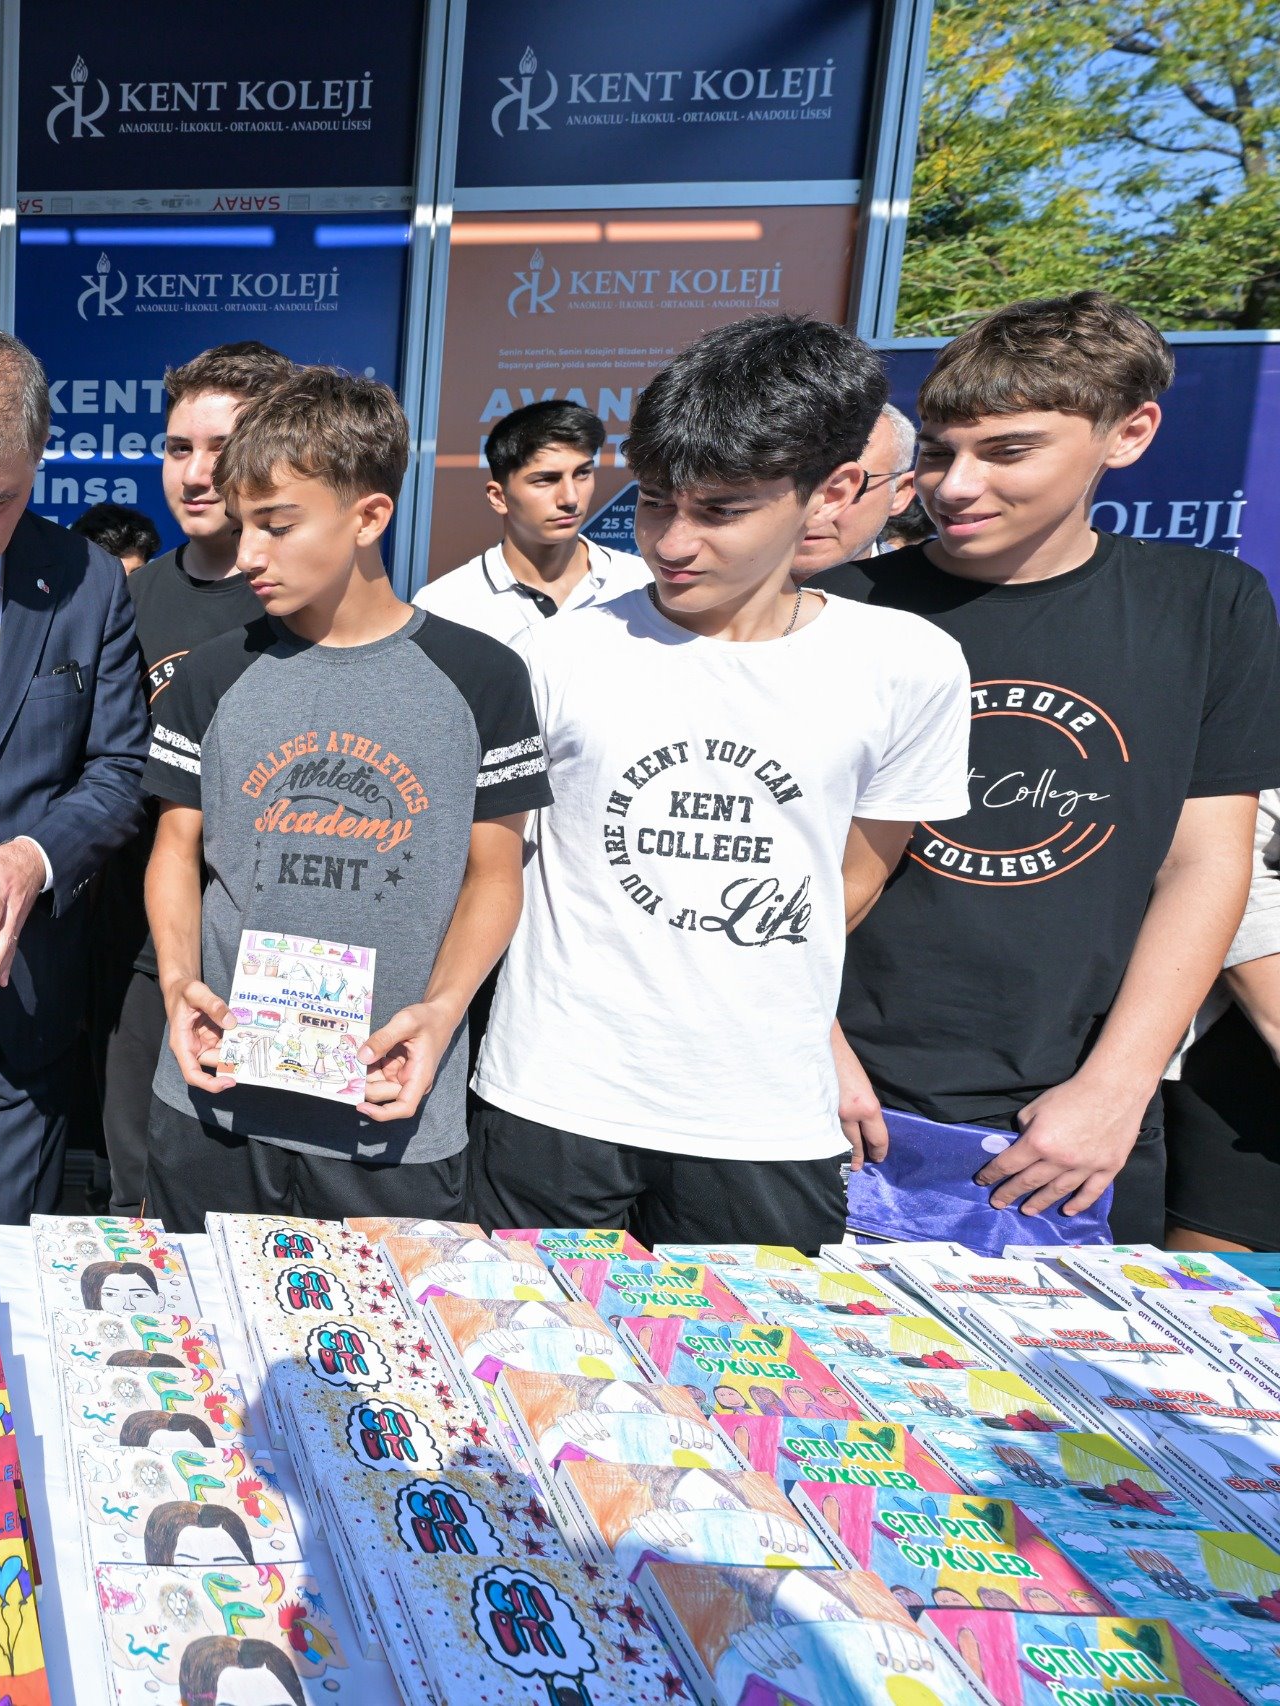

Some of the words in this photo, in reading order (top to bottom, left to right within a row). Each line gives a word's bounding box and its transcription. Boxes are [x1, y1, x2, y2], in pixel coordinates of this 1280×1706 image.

[119, 82, 227, 111] KENT
[236, 71, 373, 117] KOLEJİ
[567, 72, 682, 103] KENT
[690, 59, 836, 106] KOLEJİ
[119, 123, 173, 133] ANAOKULU
[180, 120, 223, 132] İLKOKUL
[230, 122, 283, 131] ORTAOKUL
[291, 121, 340, 131] ANADOLU
[342, 118, 371, 130] LİSESİ
[566, 114, 623, 125] ANAOKULU
[630, 111, 675, 124] İLKOKUL
[682, 111, 739, 122] ORTAOKUL
[747, 109, 798, 121] ANADOLU
[801, 107, 832, 119] LİSESİ
[209, 196, 280, 211] SARAY
[135, 274, 222, 298] KENT
[230, 267, 340, 303] KOLEJİ
[569, 270, 660, 295] KENT
[667, 262, 782, 299] KOLEJİ
[135, 304, 179, 312] ANAOKULU
[184, 303, 219, 312] İLKOKUL
[315, 302, 338, 310] LİSESİ
[49, 380, 165, 413] KENT
[42, 424, 167, 459] Gelec
[602, 518, 619, 529] 25
[1089, 489, 1247, 548] OLEJİ
[622, 741, 688, 789] KENT
[705, 739, 757, 768] YOU
[242, 731, 318, 799] COLLEGE
[326, 731, 429, 814] ATHLETICS
[274, 757, 380, 804] Athletic
[754, 759, 803, 804] CAN
[607, 790, 633, 818] IN
[669, 791, 754, 823] KENT
[983, 769, 1110, 817] College
[255, 798, 412, 853] Academy
[604, 825, 631, 866] ARE
[637, 827, 773, 863] COLLEGE
[923, 840, 1056, 877] COLLEGE
[278, 853, 368, 890] KENT
[620, 874, 663, 915] YOU
[669, 908, 696, 931] IF
[700, 875, 811, 947] Life
[239, 992, 258, 1000] BİR
[262, 996, 297, 1007] CANLI
[301, 1002, 364, 1020] OLSAYDIM
[282, 988, 321, 1001] BAŞKA
[301, 1015, 337, 1029] KENT
[611, 1274, 651, 1288] ÇITI
[962, 1284, 1011, 1295] CANLI
[1009, 1286, 1088, 1299] OLSAYDIM
[968, 1274, 1026, 1286] BAŞKA
[619, 1288, 715, 1309] ÖYKÜLER
[1155, 1301, 1193, 1330] GÜZELBAHÇE
[684, 1335, 728, 1352] ÇITI
[729, 1338, 778, 1358] PITI
[1045, 1339, 1096, 1351] CANLI
[1095, 1340, 1185, 1355] OLSAYDIM
[1050, 1328, 1115, 1342] BAŞKA
[1151, 1319, 1165, 1332] PITI
[1164, 1329, 1195, 1356] ÖYKÜLER
[693, 1353, 802, 1381] ÖYKÜLER
[1244, 1370, 1259, 1383] PITI
[842, 1375, 865, 1399] BORNOVA
[1147, 1387, 1220, 1405] BAŞKA
[1139, 1399, 1202, 1416] CANLI
[784, 1437, 841, 1459] ÇITI
[835, 1440, 894, 1463] PITI
[922, 1440, 949, 1467] BORNOVA
[797, 1461, 926, 1491] ÖYKÜLER
[1163, 1444, 1197, 1473] BORNOVA
[1197, 1472, 1229, 1501] KAMPÜS
[1222, 1475, 1266, 1493] BİR
[1169, 1474, 1204, 1506] OLSAYDIM
[802, 1502, 826, 1533] BORNOVA
[826, 1533, 853, 1570] KAMPÜSÜ
[879, 1509, 942, 1538] ÇITI
[937, 1512, 1006, 1545] PITI
[896, 1536, 1043, 1581] ÖYKÜLER
[489, 1610, 567, 1659] PITI
[1022, 1643, 1101, 1681] ÇITI
[1084, 1646, 1170, 1683] PITI
